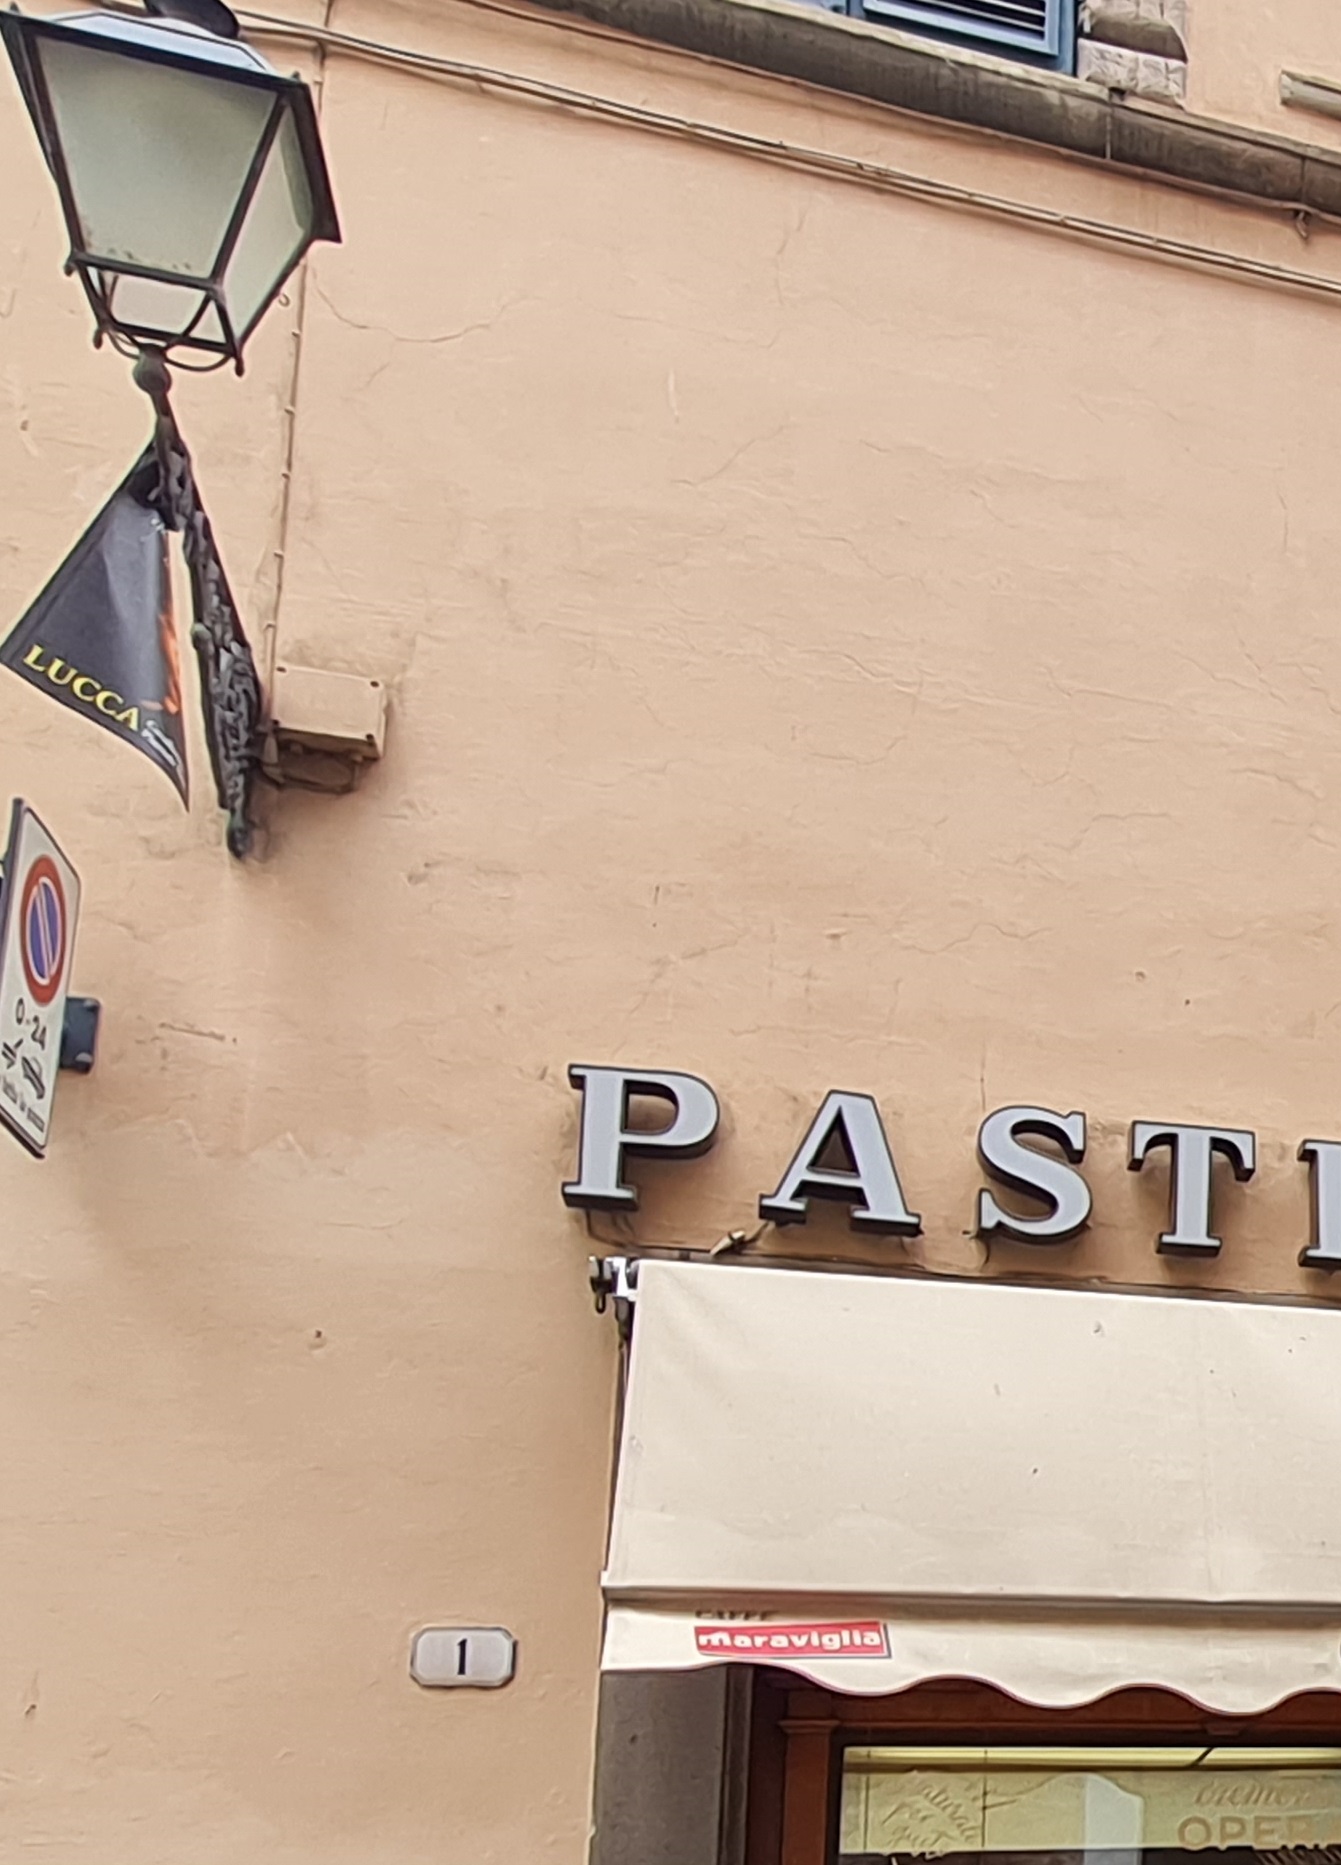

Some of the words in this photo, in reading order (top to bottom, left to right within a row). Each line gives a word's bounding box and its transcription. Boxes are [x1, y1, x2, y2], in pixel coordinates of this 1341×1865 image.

[23, 643, 140, 732] LUCCA
[455, 1637, 468, 1677] 1
[698, 1629, 882, 1652] maraviglia
